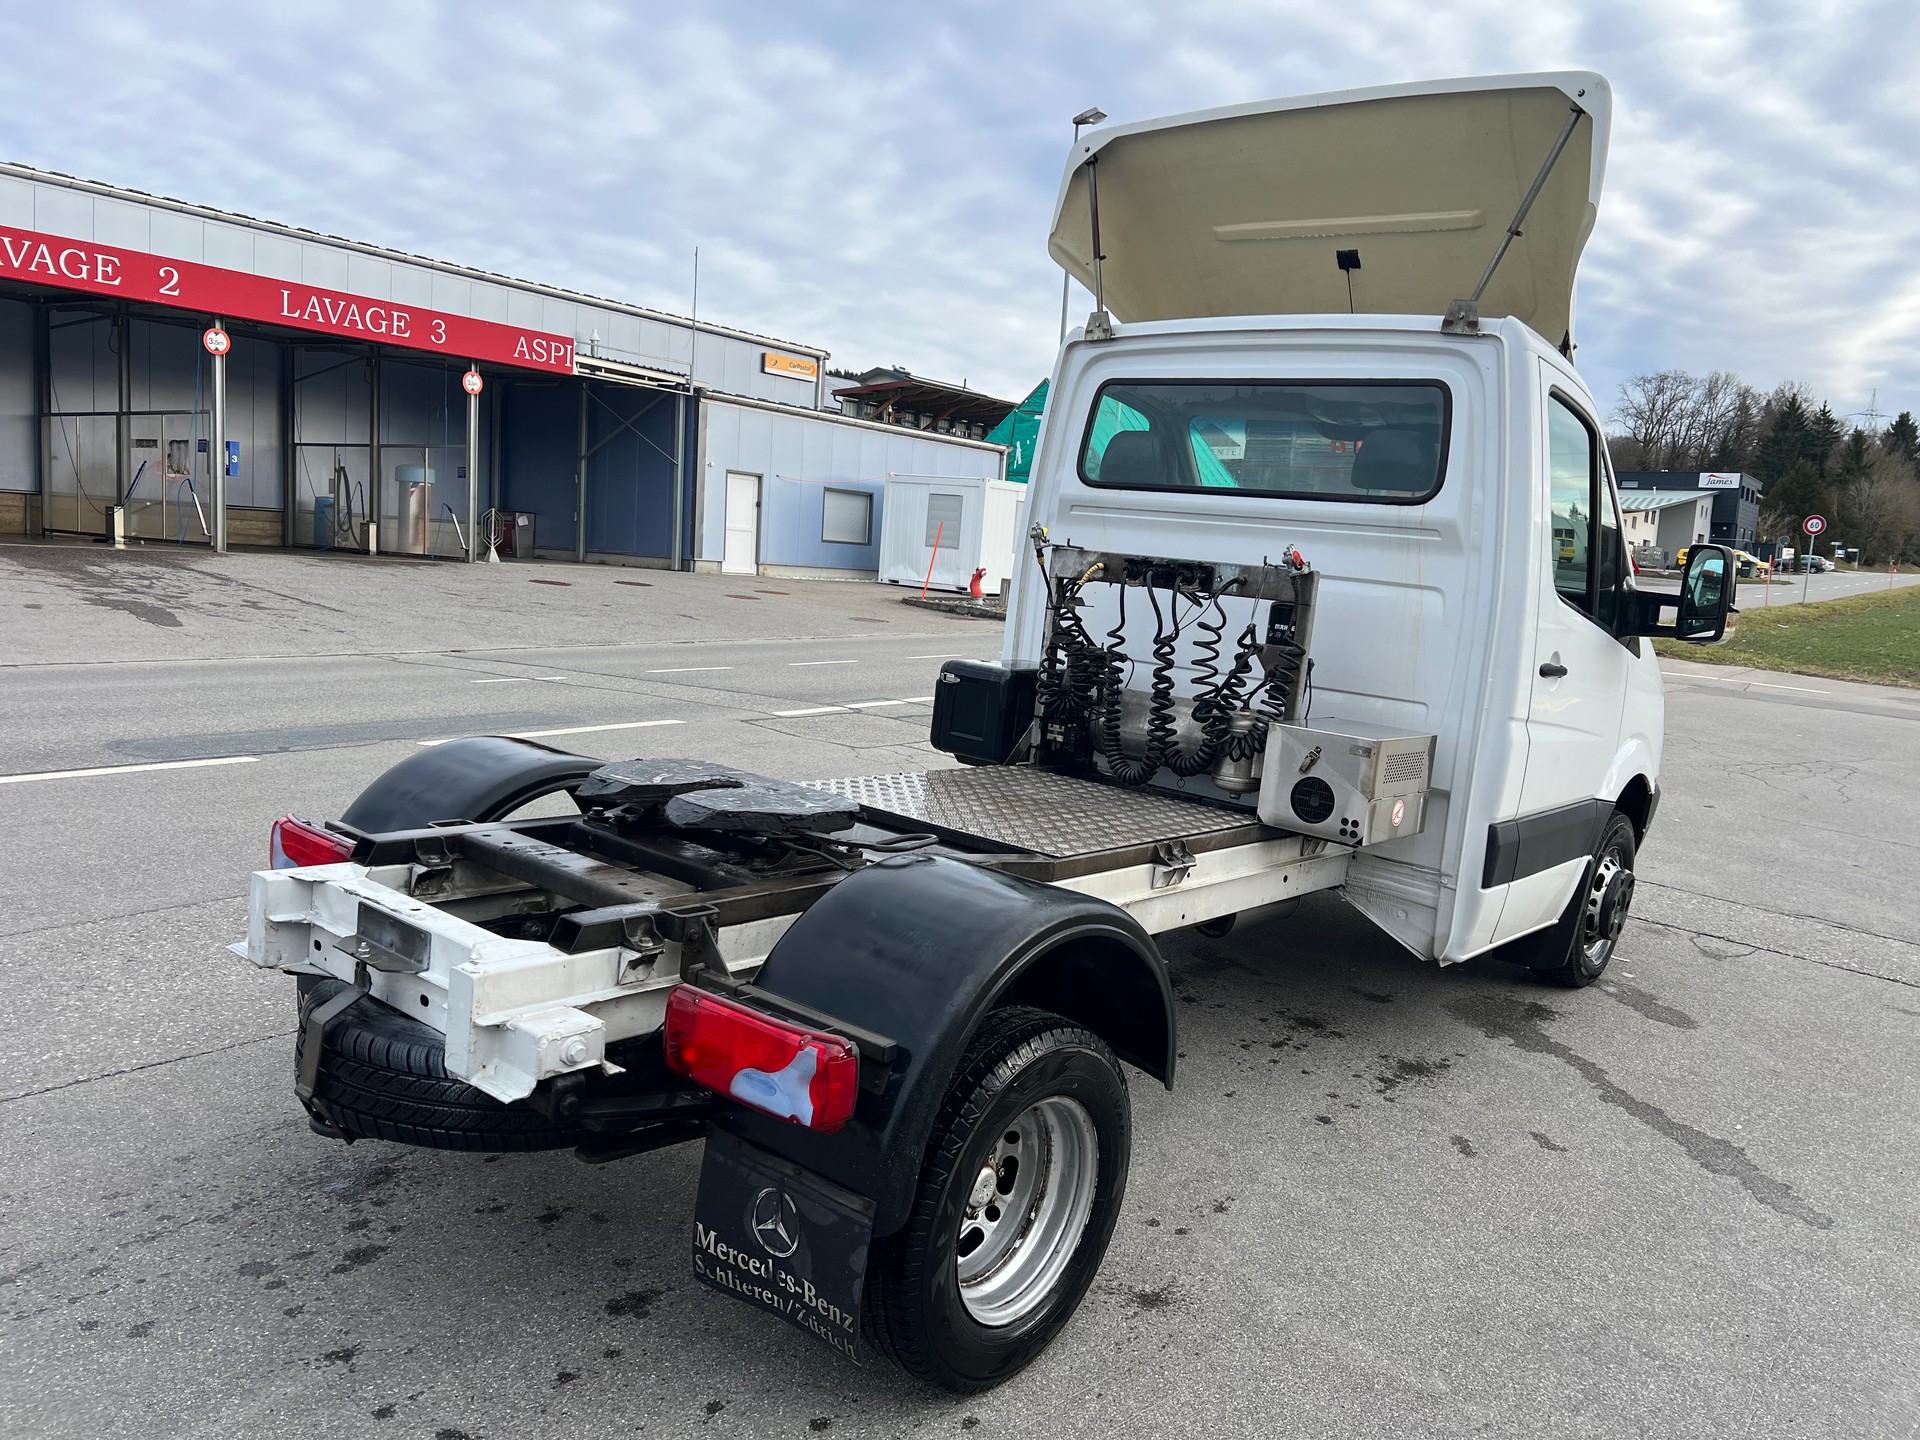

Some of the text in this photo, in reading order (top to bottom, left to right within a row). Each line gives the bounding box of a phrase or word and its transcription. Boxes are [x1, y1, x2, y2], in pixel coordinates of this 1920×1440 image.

[0, 236, 180, 297] VAGE 2
[280, 289, 447, 344] LAVAGE 3
[513, 336, 573, 368] ASPI
[231, 454, 238, 463] 3
[1705, 477, 1733, 486] James
[1809, 521, 1820, 529] 60
[694, 1221, 854, 1334] Mercedes-Benz
